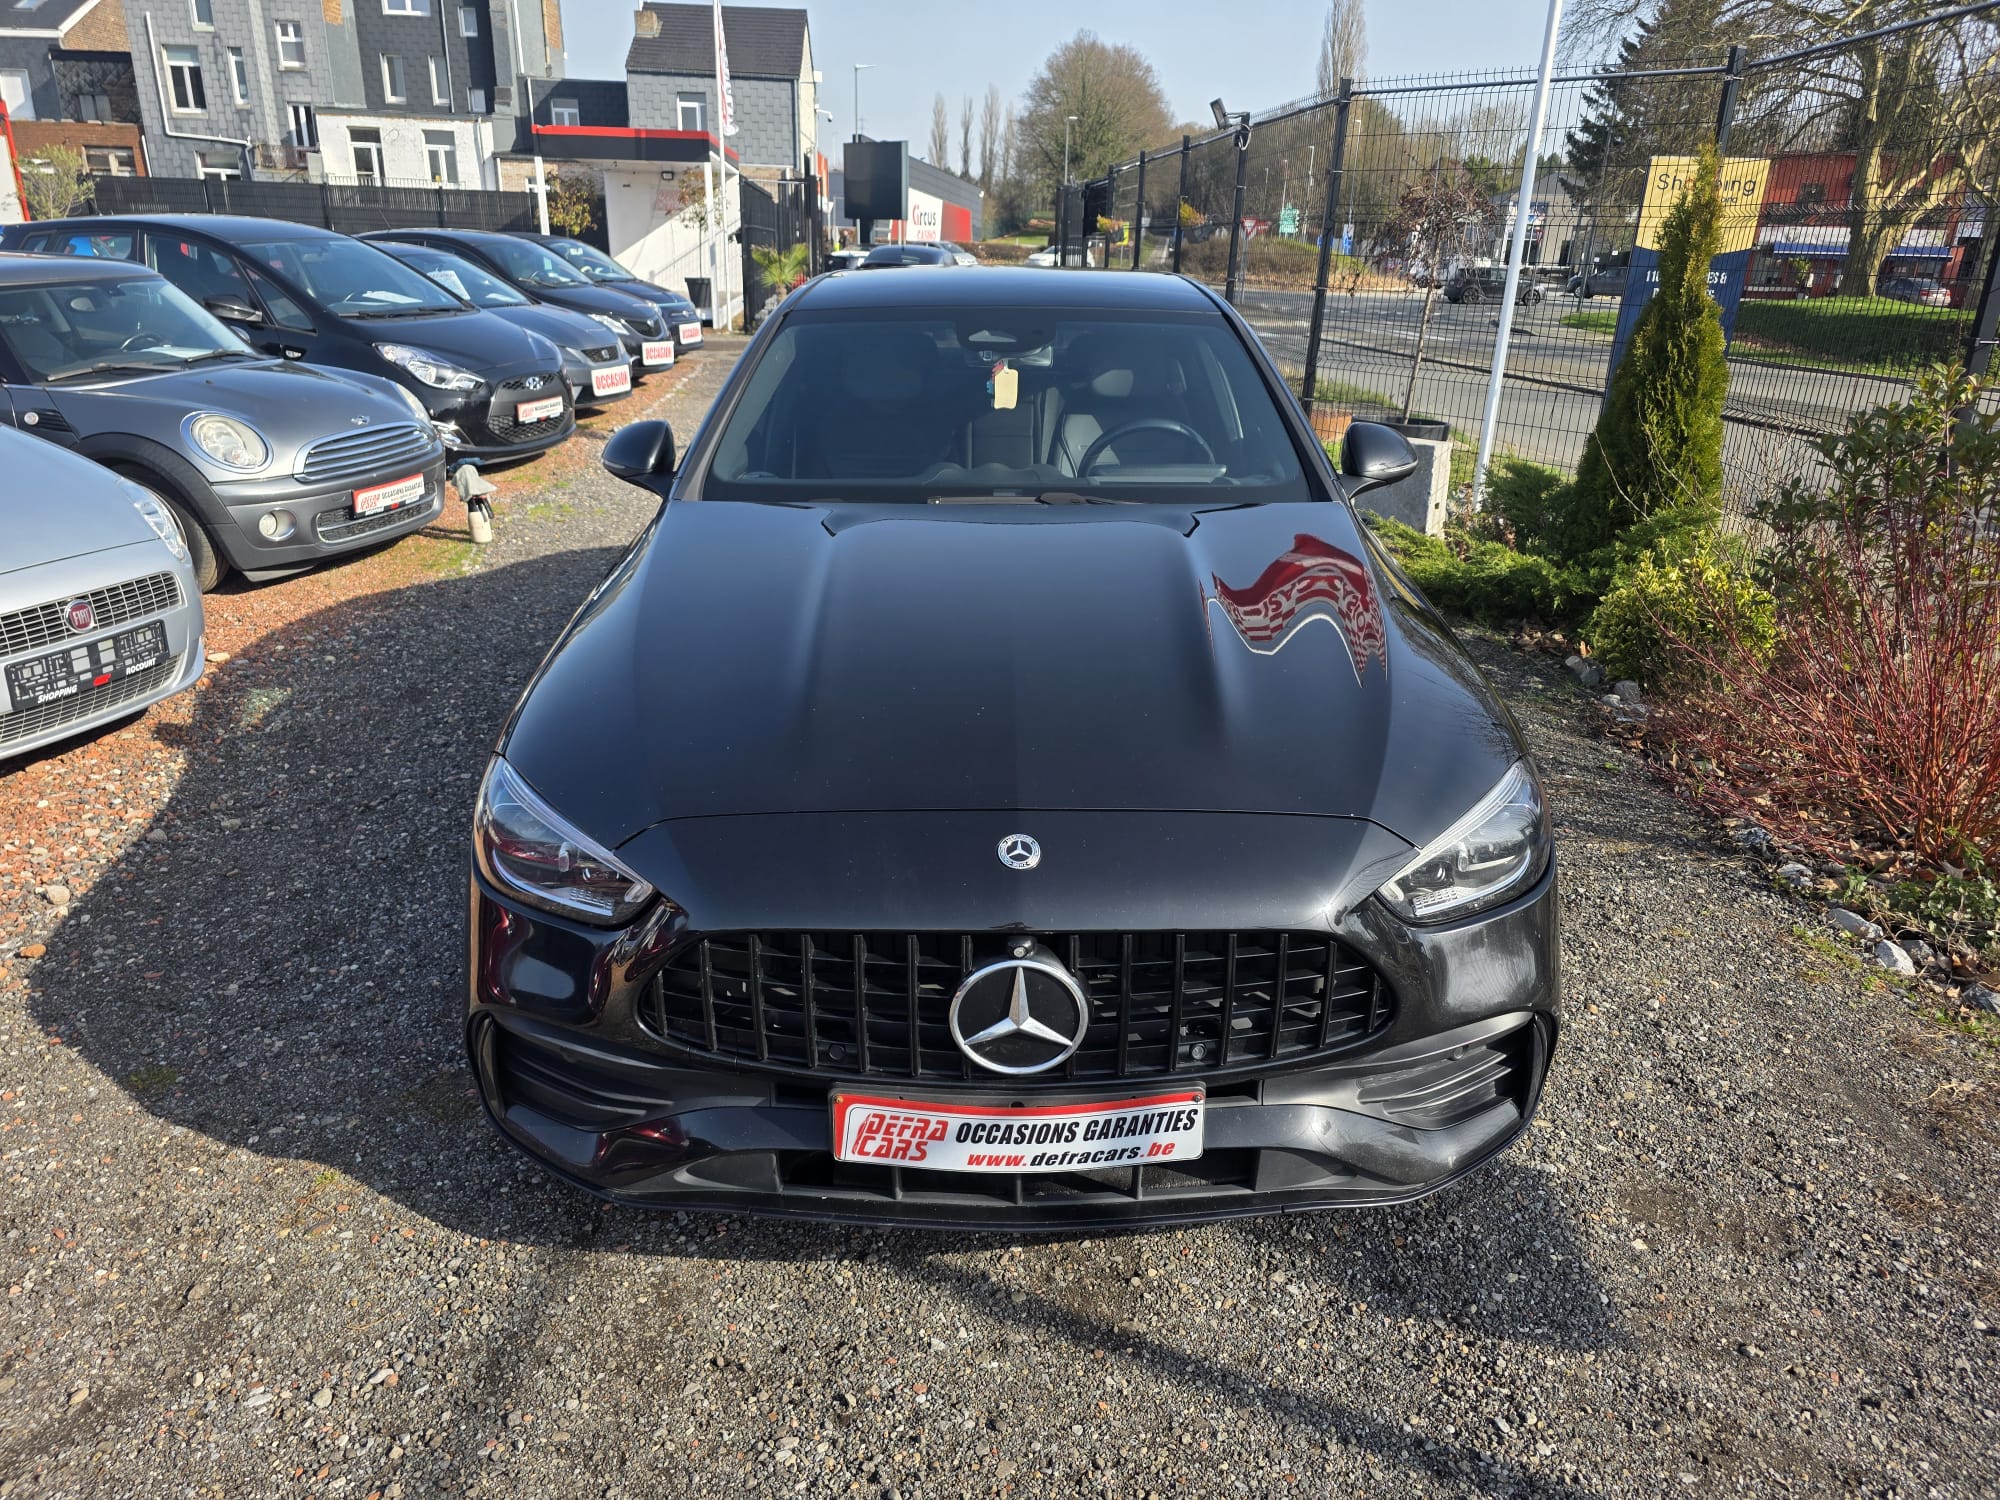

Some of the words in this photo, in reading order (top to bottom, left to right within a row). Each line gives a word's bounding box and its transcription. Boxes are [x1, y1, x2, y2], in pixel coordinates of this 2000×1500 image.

[1657, 173, 1757, 197] Shoing
[912, 203, 937, 226] Circus
[645, 345, 672, 361] OCCASION
[595, 371, 629, 391] OCCASION
[73, 607, 91, 626] FIAT
[38, 684, 78, 704] SHOPPING
[126, 657, 157, 676] ROCOURT
[865, 1112, 949, 1142] DEFRA
[955, 1119, 1080, 1145] OCCASIONS
[1083, 1108, 1199, 1142] GARANTIES
[857, 1135, 929, 1162] CARS
[967, 1141, 1176, 1167] www.defracars.be
